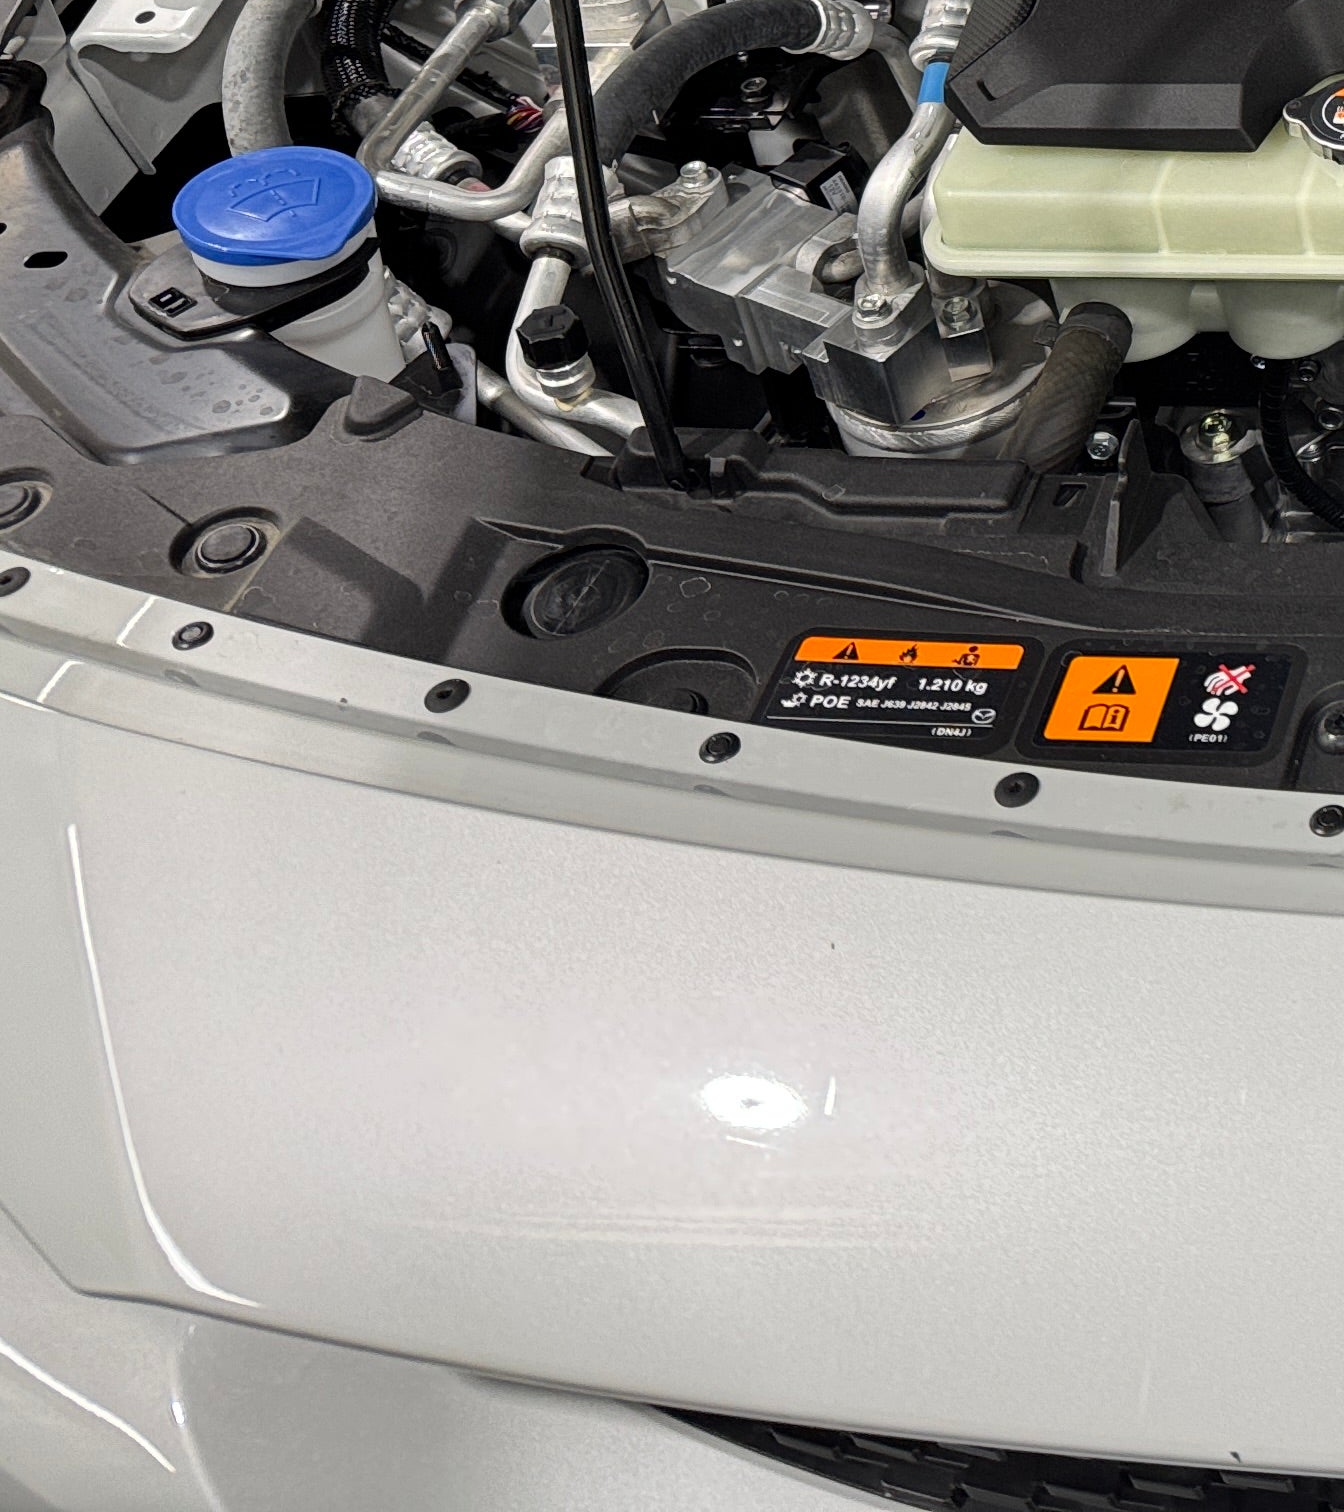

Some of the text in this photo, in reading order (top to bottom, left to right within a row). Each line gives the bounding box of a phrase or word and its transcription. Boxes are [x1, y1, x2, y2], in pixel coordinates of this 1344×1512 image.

[818, 673, 988, 696] R-1234yf 1.210 kg
[809, 694, 852, 709] POE
[856, 698, 880, 708] SAE
